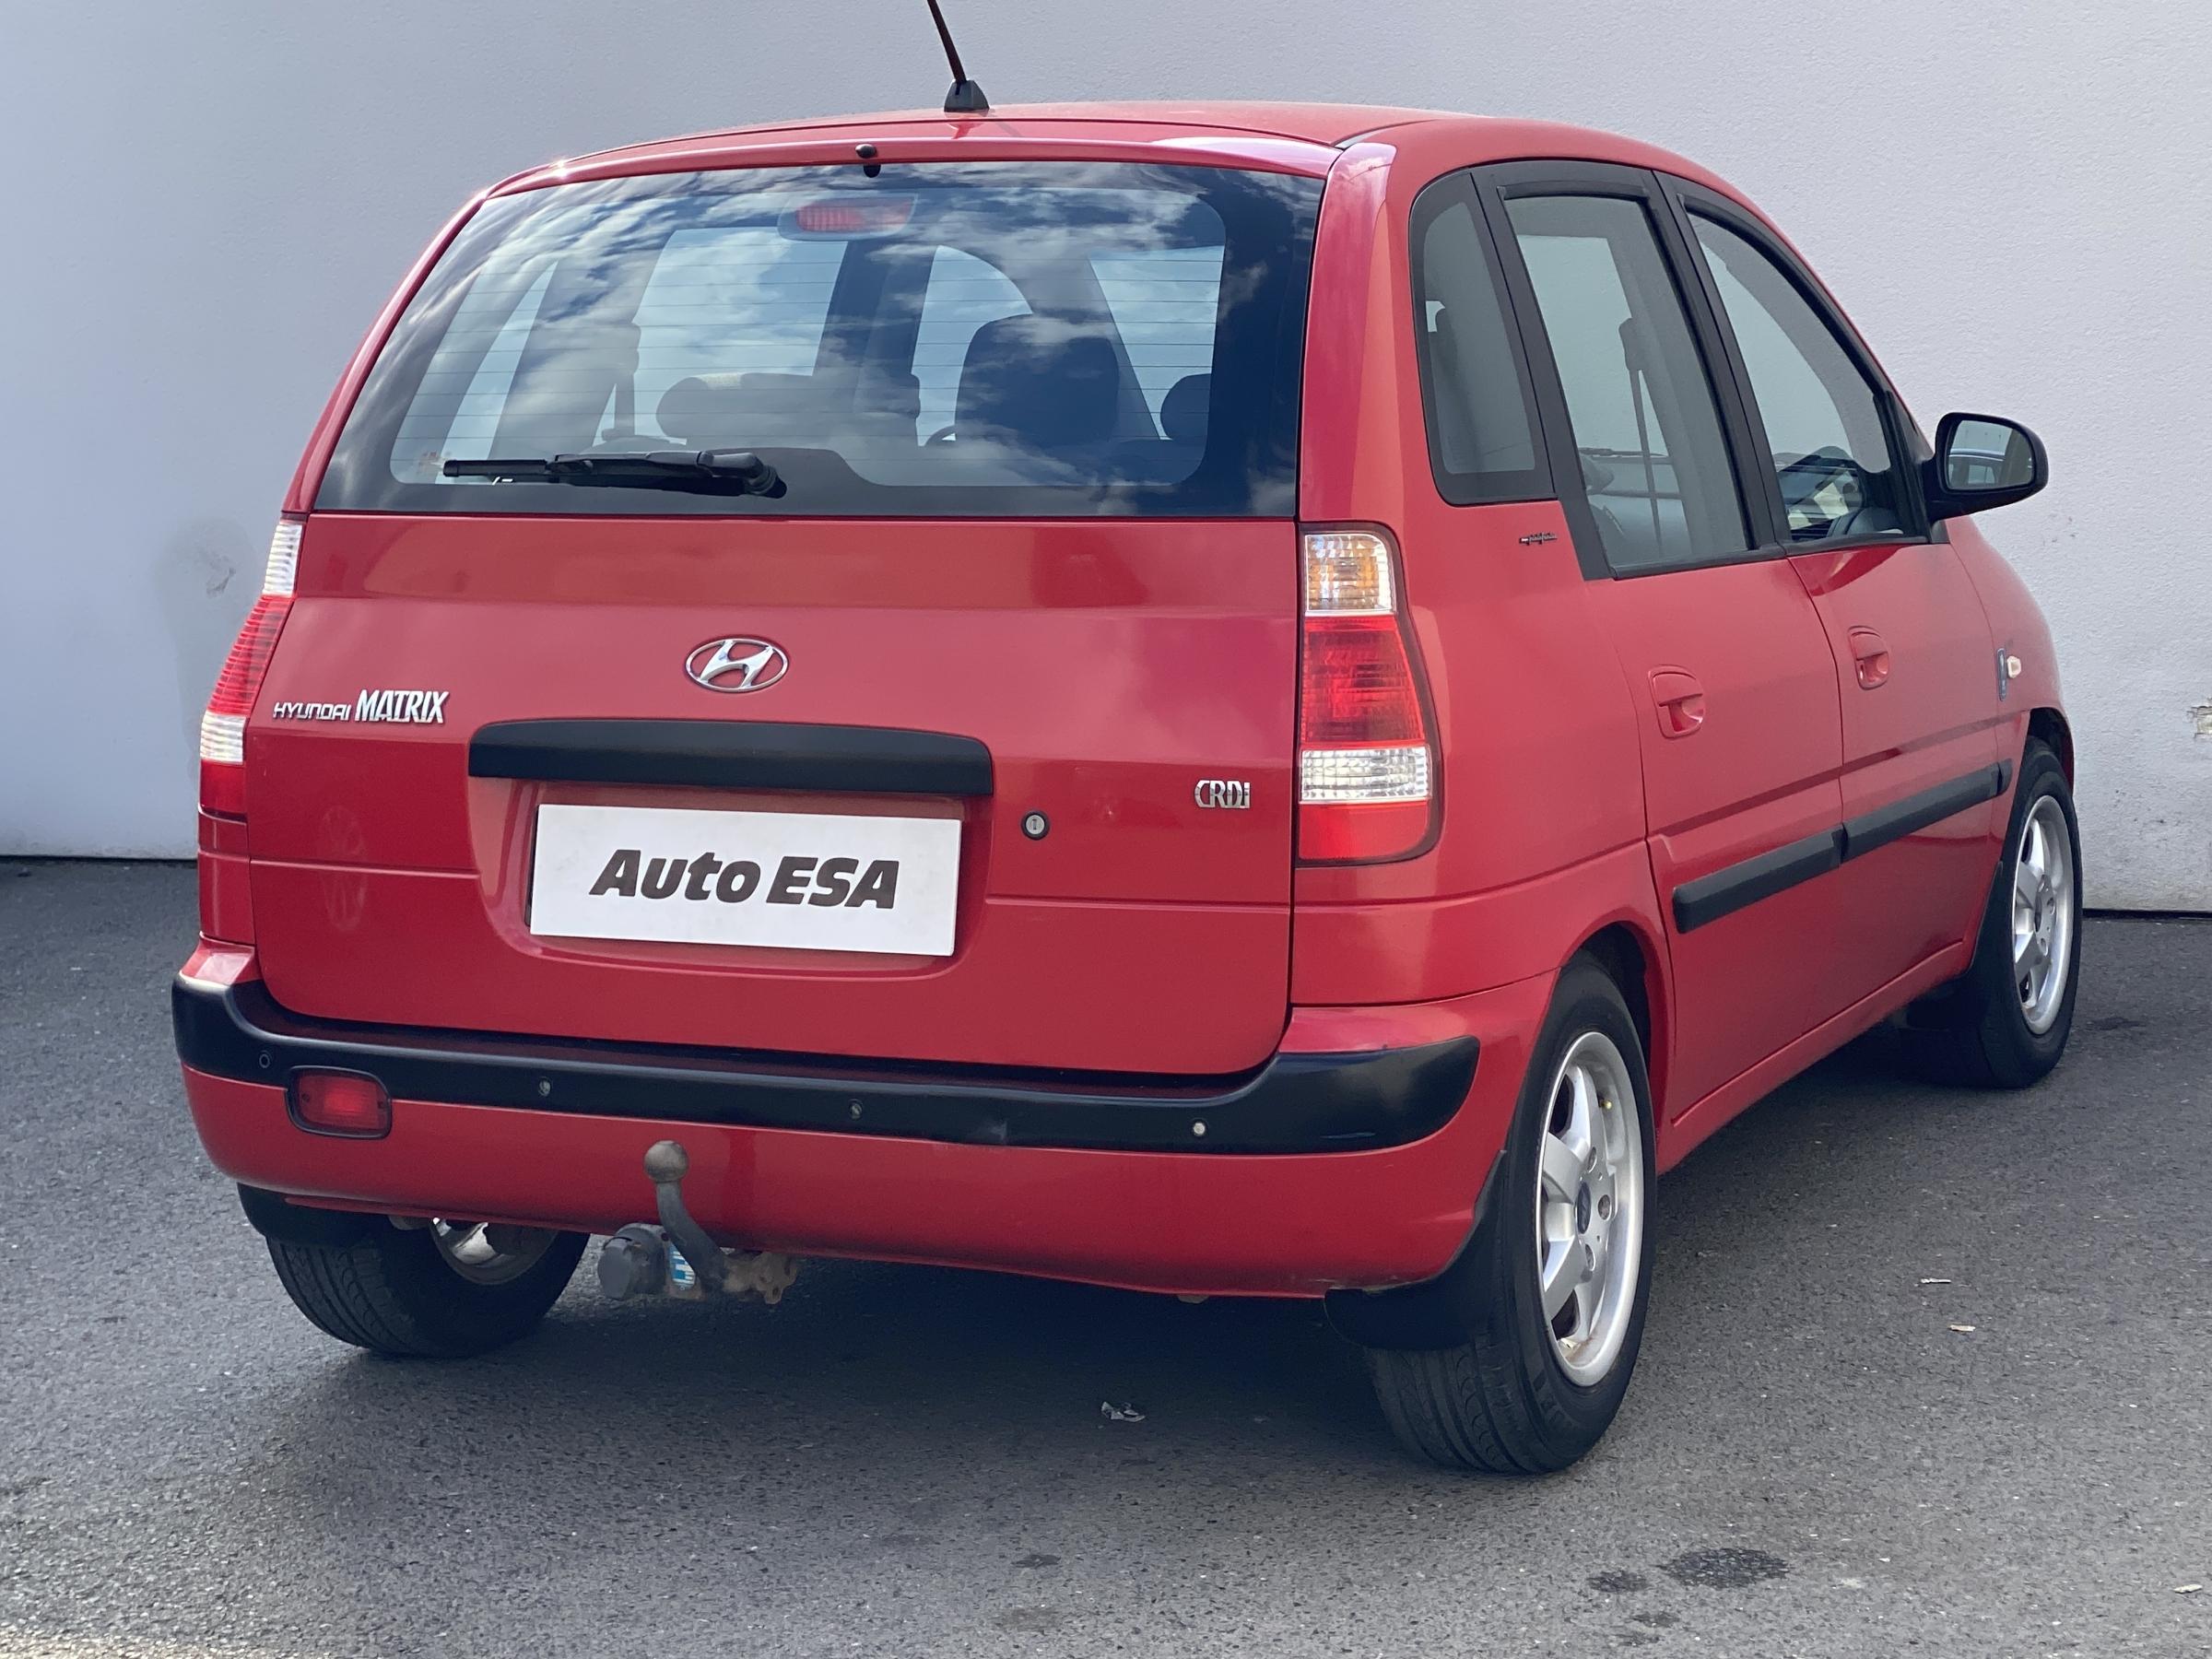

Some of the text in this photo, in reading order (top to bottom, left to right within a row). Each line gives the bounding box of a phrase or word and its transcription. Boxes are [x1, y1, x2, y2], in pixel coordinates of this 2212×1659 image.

[273, 688, 450, 724] HYUNDAI MATRIX
[588, 849, 900, 910] Auto ESA
